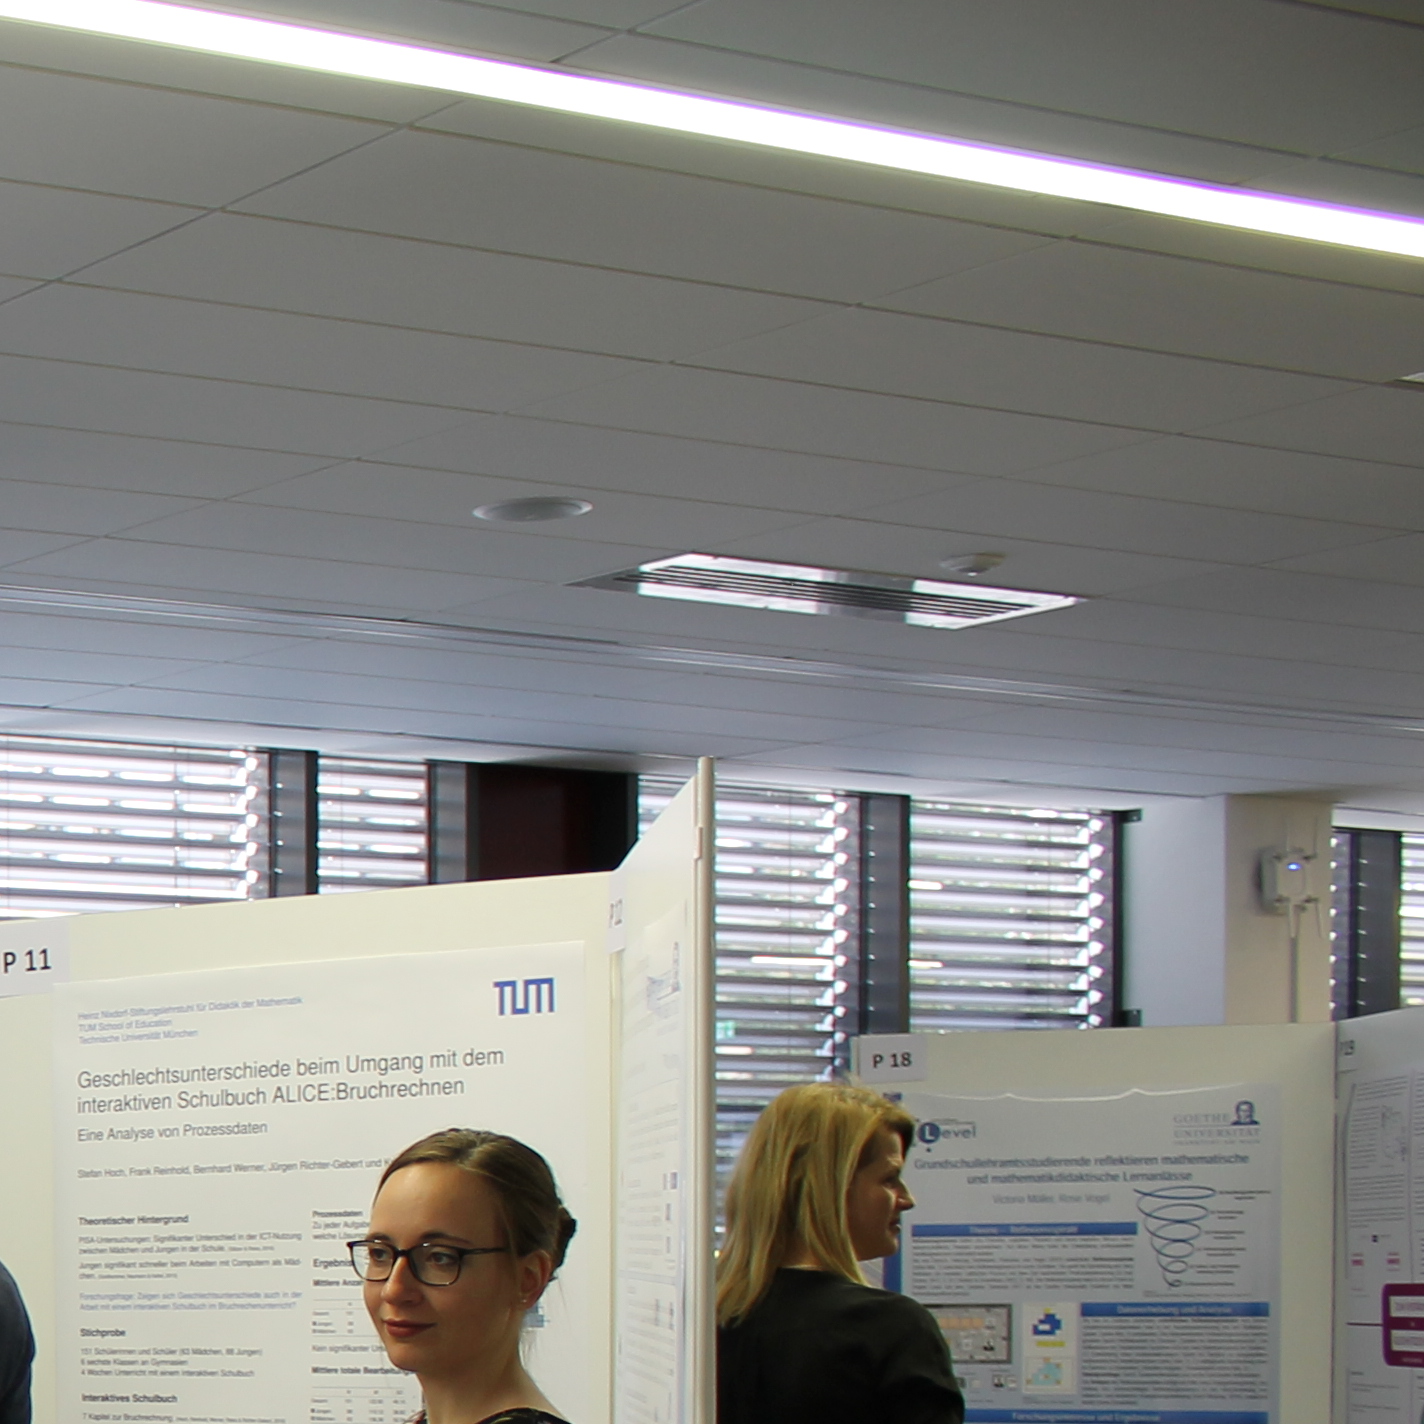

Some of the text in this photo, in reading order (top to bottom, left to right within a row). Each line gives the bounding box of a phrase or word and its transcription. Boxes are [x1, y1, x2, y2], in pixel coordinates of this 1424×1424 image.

[3, 948, 52, 973] P 11
[493, 977, 555, 1016] TUM
[98, 1022, 124, 1031] School
[873, 1053, 912, 1068] P 18
[77, 1048, 503, 1087] Geschlechtsunterschiede beim Umgang mit dem
[77, 1080, 464, 1112] interaktiven Schulbuch ALICE:Bruchrechnen
[77, 1122, 267, 1141] Eine Analyse von Prozessdaten
[128, 1167, 151, 1176] Frank
[966, 1174, 989, 1184] und
[78, 1215, 189, 1225] Theoretischer Hintergrund
[79, 1328, 126, 1337] Stichprobe
[81, 1394, 177, 1402] Interaktives Schulbuch
